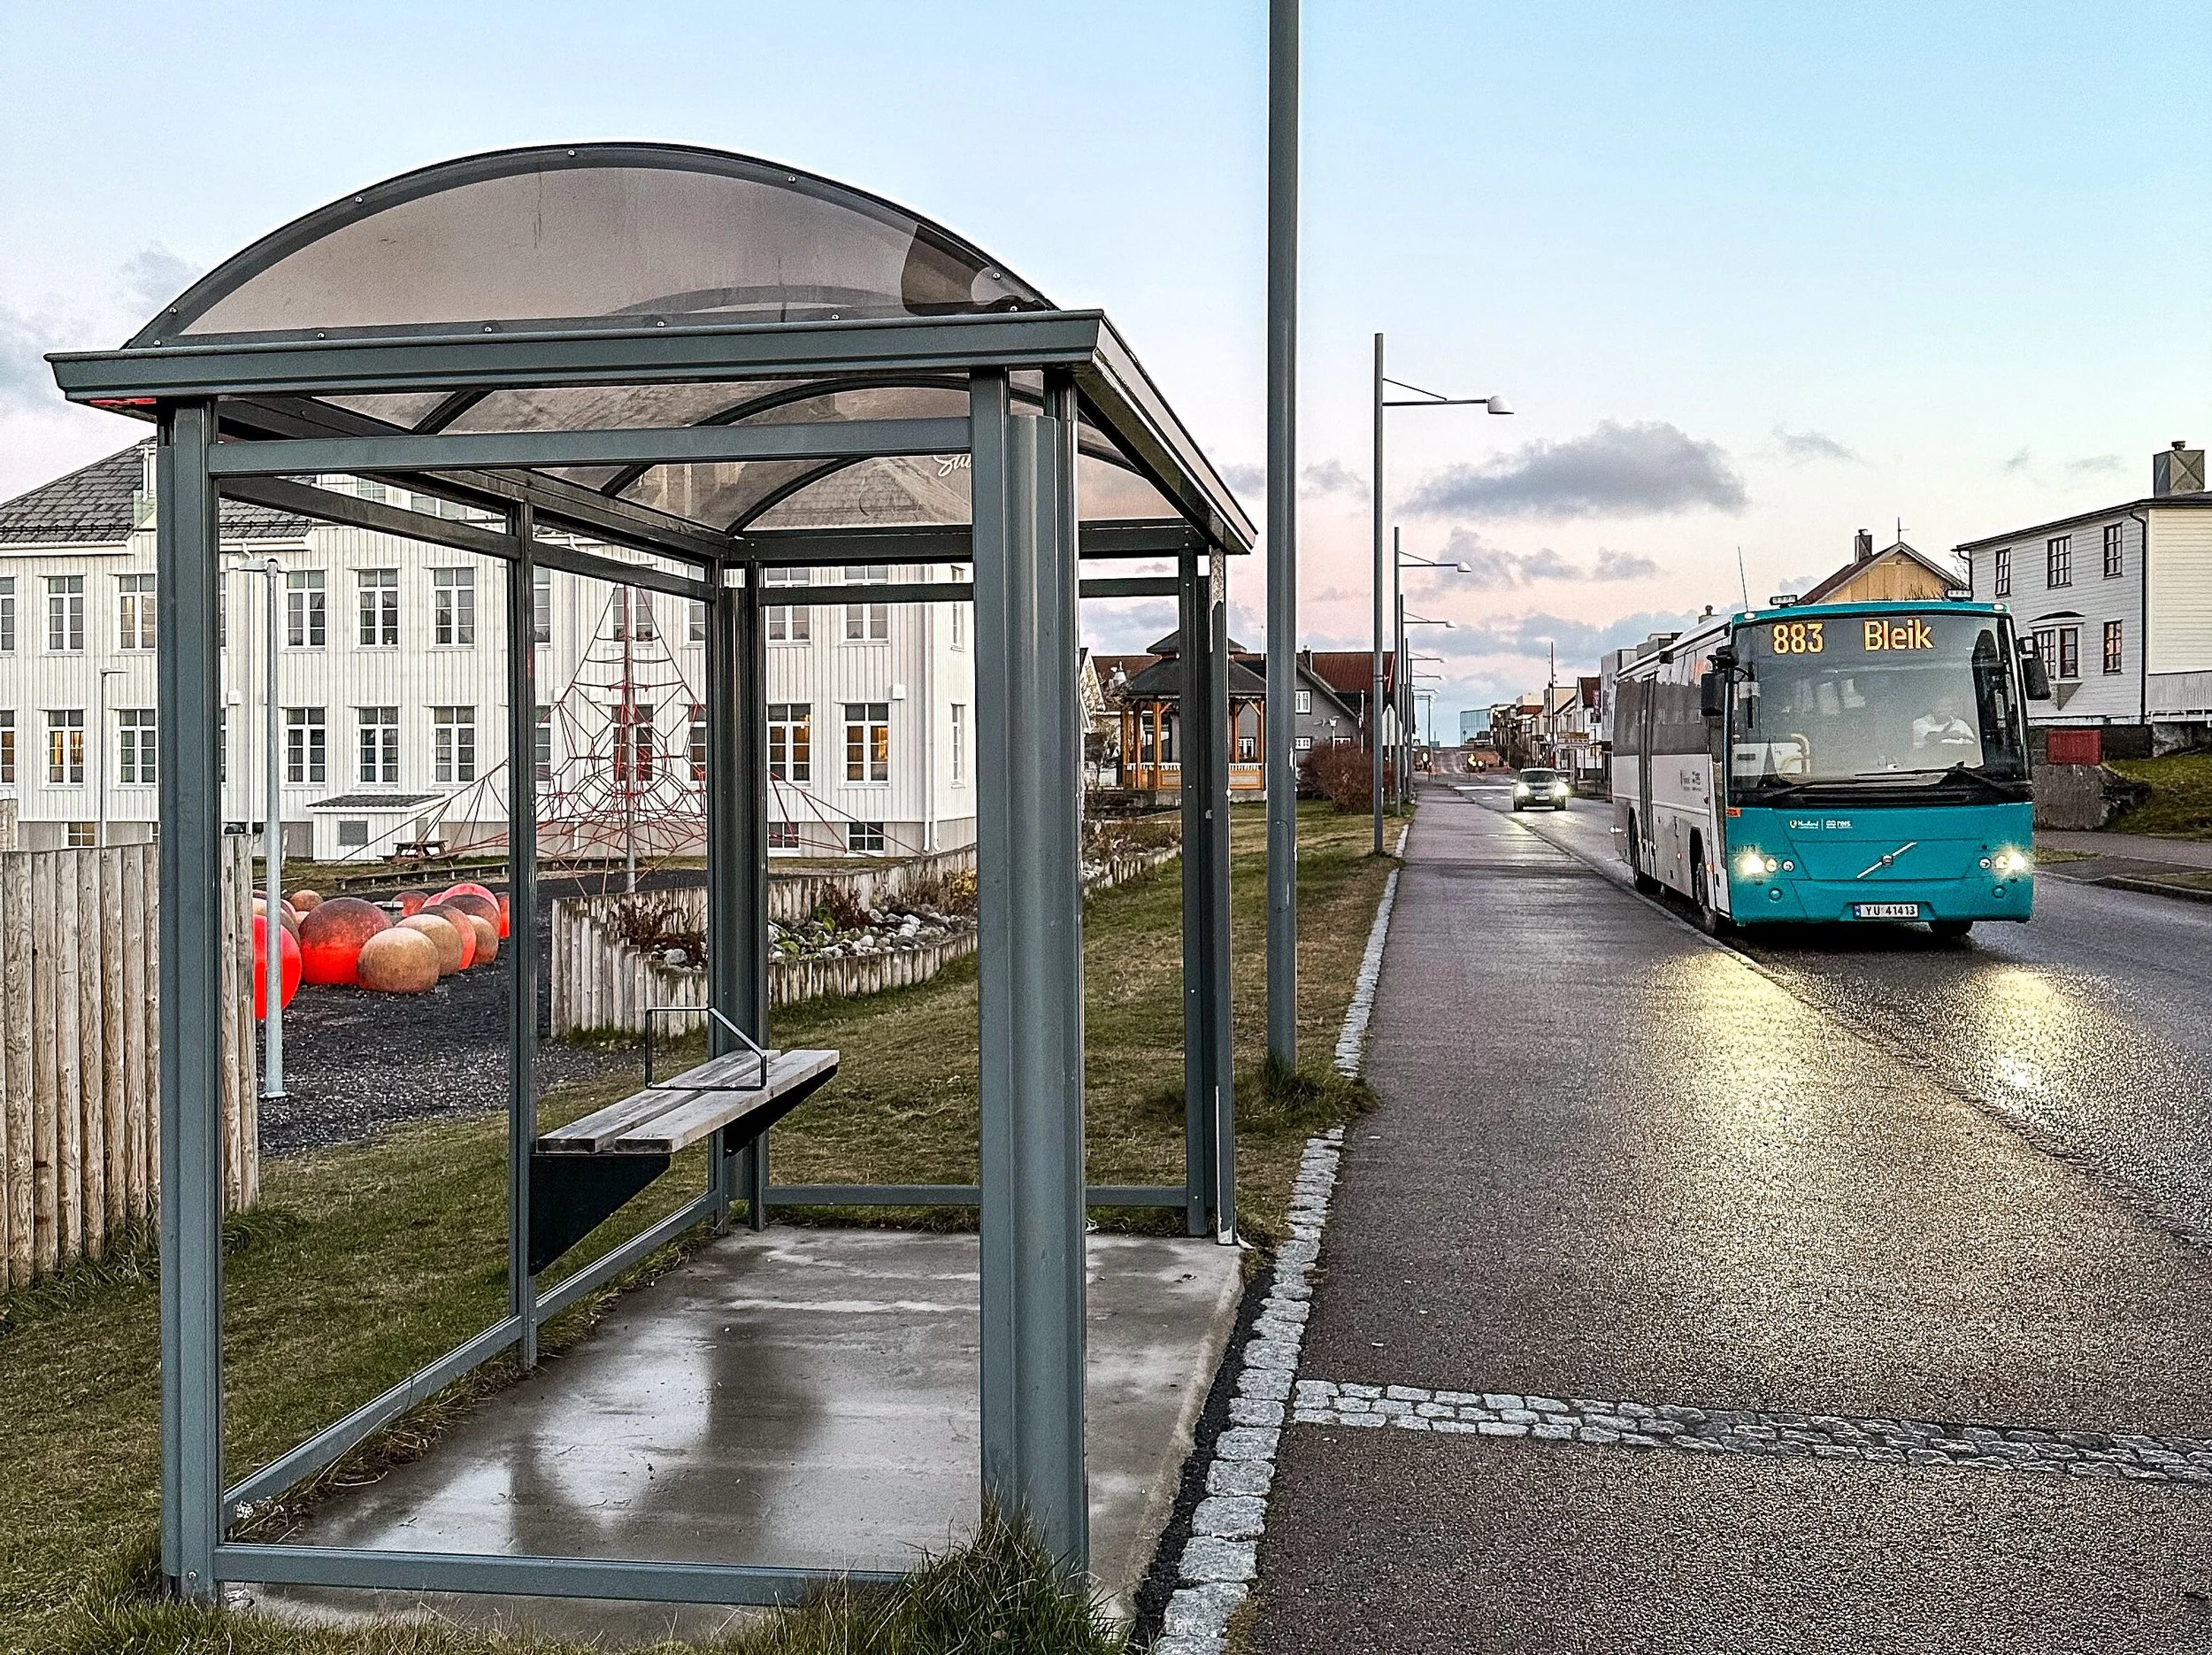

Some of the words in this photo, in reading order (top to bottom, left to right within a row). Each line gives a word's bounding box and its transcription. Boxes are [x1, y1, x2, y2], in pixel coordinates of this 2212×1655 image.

[1772, 622, 1824, 655] 883
[1863, 618, 1935, 651] Bleik
[1865, 905, 1881, 916] YU
[1885, 905, 1916, 916] 41413
